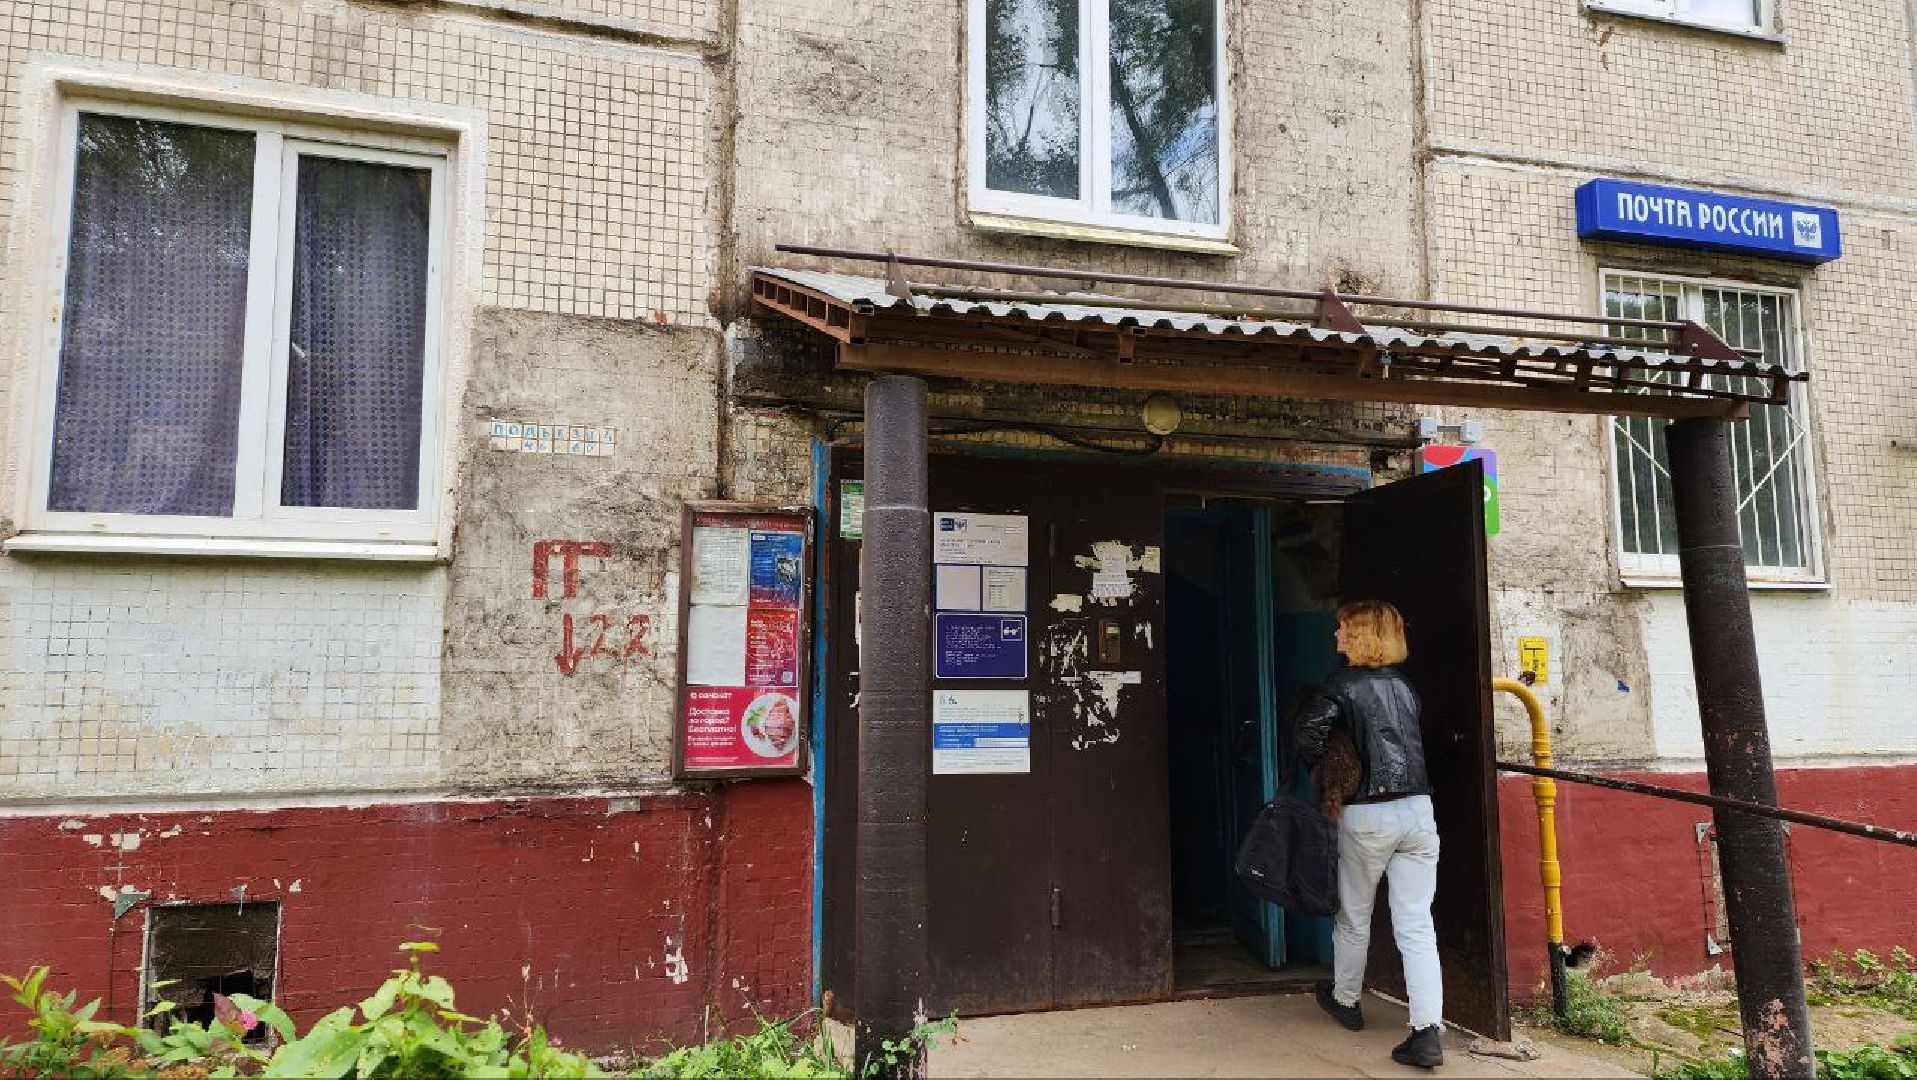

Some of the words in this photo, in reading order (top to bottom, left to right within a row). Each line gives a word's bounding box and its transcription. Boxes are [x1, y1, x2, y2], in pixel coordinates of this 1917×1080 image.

[1617, 192, 1692, 228] ПОЧТА
[1698, 202, 1784, 240] РОССИИ
[689, 708, 730, 716] Доставка
[688, 725, 736, 733] Бесплатно!
